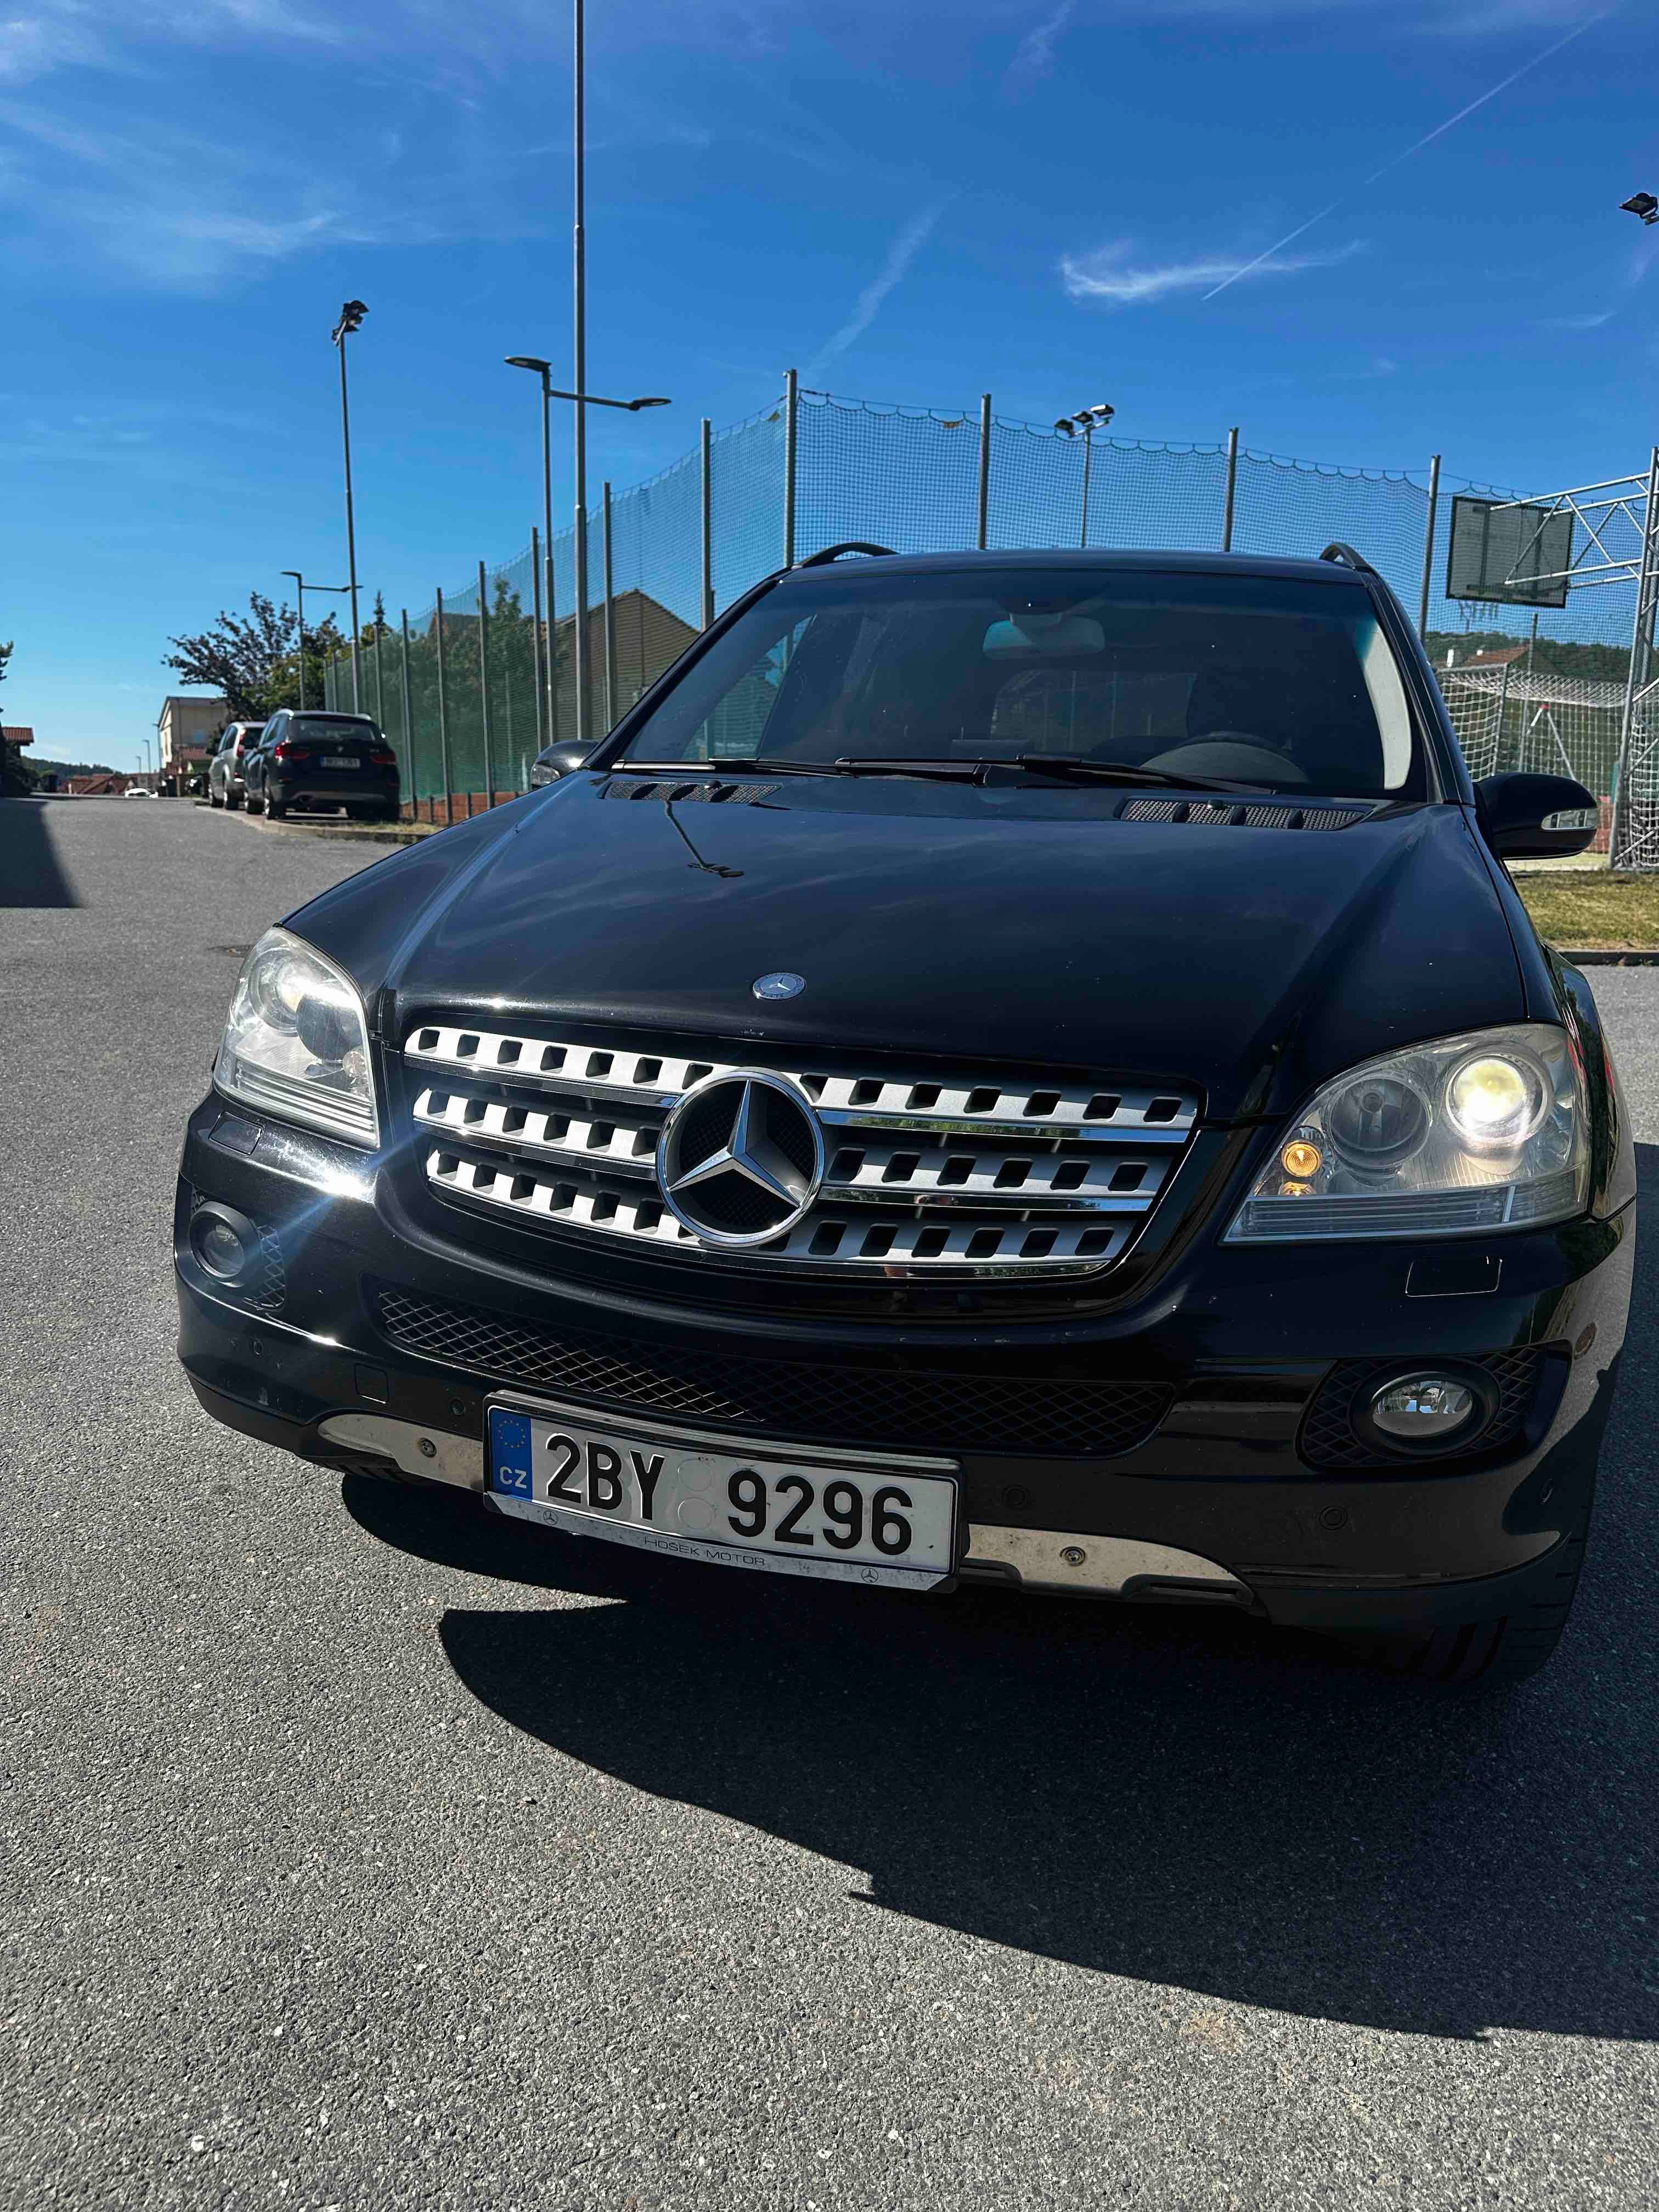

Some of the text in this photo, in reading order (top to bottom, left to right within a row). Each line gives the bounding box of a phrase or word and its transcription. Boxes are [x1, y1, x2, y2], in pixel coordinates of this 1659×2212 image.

[499, 1466, 527, 1489] CZ
[545, 1432, 913, 1556] 2BY 9296
[706, 1549, 765, 1565] MOTOR
